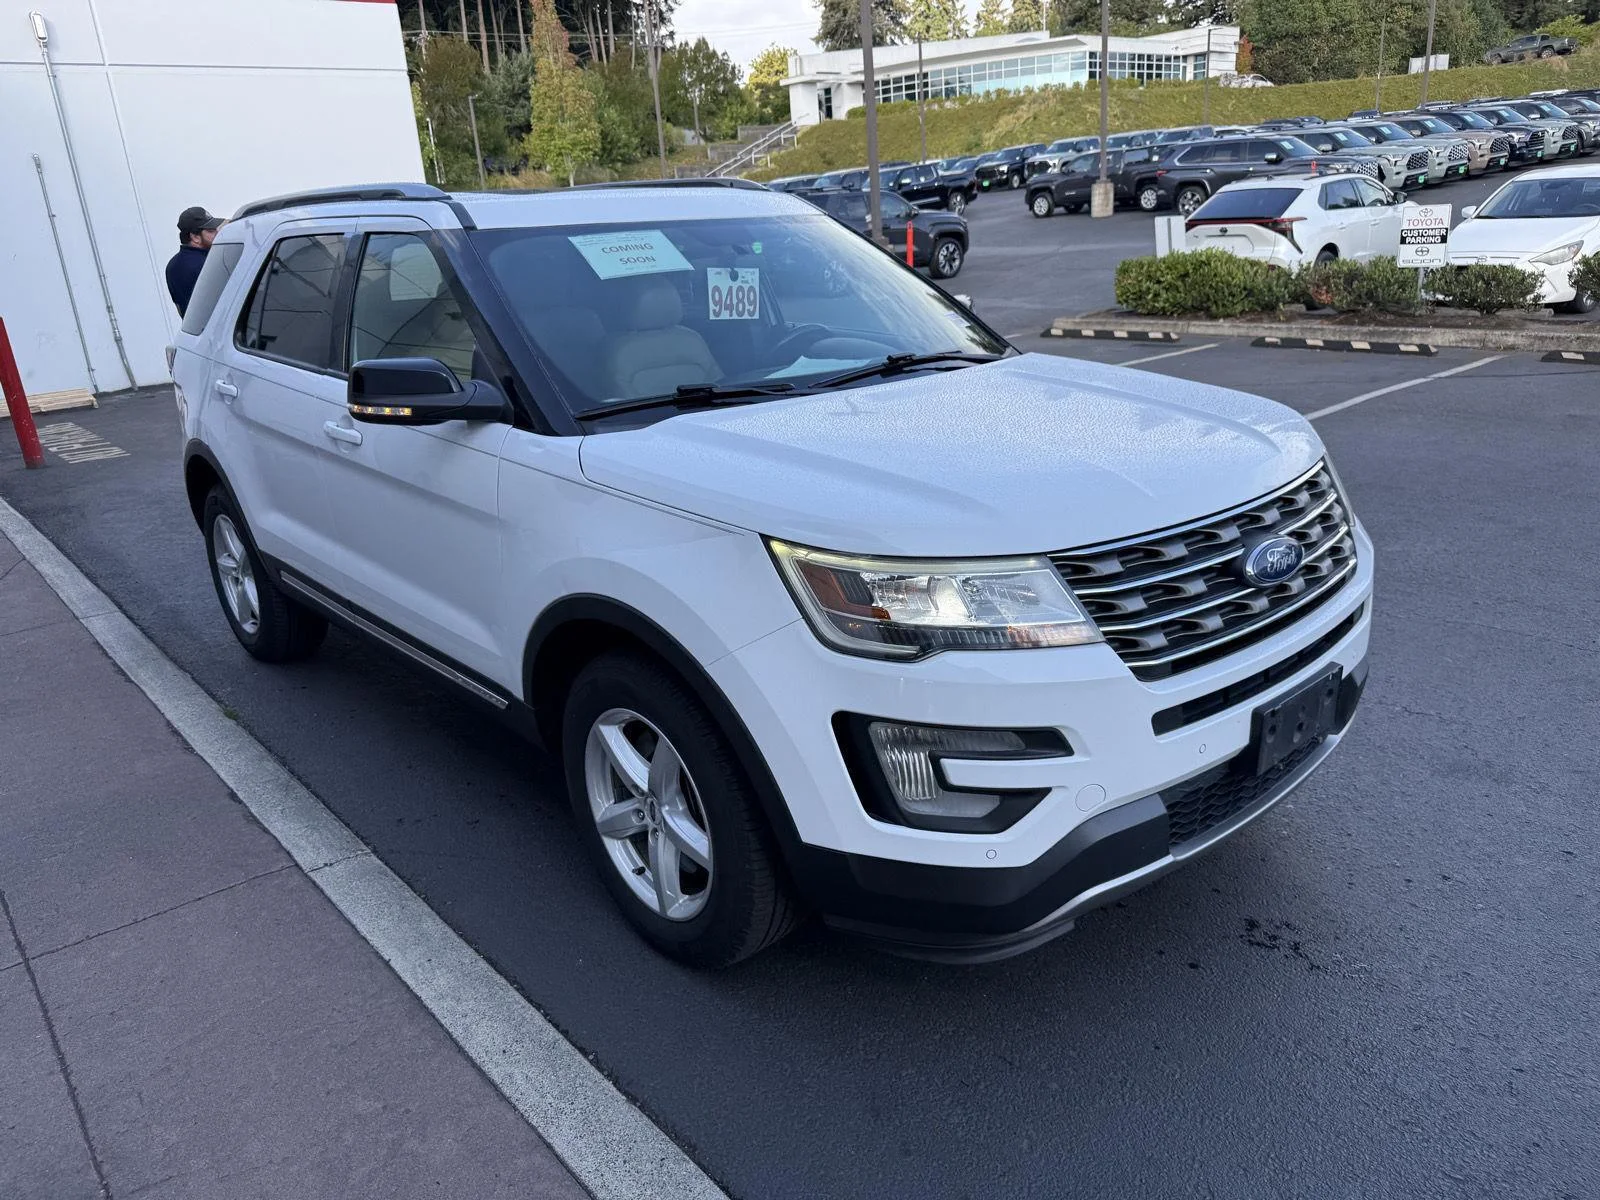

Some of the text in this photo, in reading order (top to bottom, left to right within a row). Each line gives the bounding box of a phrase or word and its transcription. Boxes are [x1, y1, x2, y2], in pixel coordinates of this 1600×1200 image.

[1407, 217, 1444, 227] TOYOTA
[1402, 229, 1446, 237] CUSTOMER
[1405, 236, 1441, 244] PARKING
[601, 242, 654, 254] COMING
[619, 255, 656, 265] SOON
[711, 285, 757, 318] 9489
[1266, 544, 1297, 573] Ford
